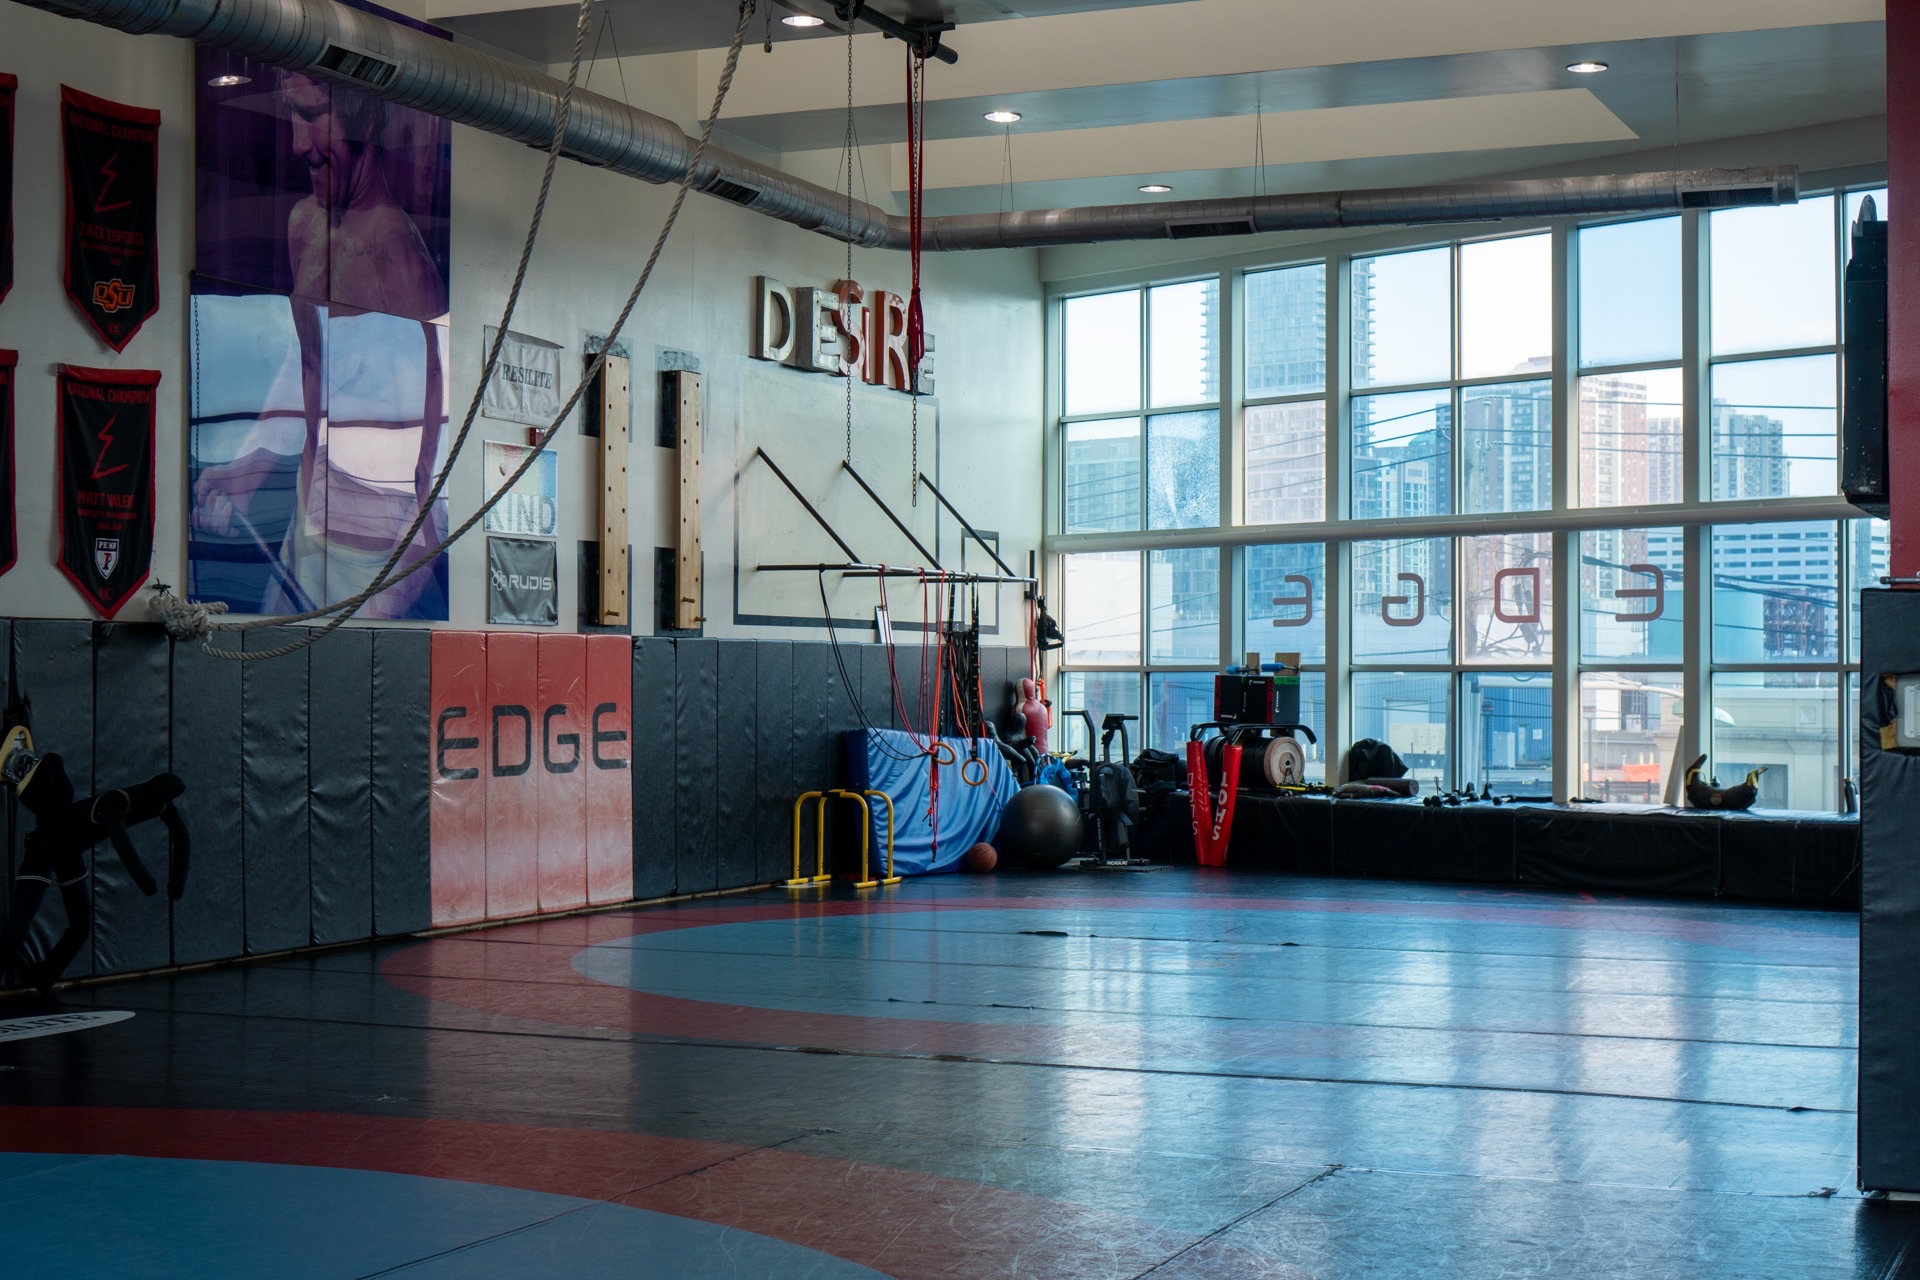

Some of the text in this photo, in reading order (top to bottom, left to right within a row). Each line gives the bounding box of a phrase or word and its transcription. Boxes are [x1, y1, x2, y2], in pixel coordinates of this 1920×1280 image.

[94, 280, 134, 311] OSU
[756, 275, 936, 395] DESIRE
[502, 363, 552, 390] RESILITE
[66, 381, 150, 404] NATIONAL CHAMPION
[77, 489, 105, 506] MATT
[486, 490, 556, 534] KIND
[98, 541, 117, 549] PENN
[508, 574, 552, 591] RUDIS
[437, 702, 628, 780] EDGE
